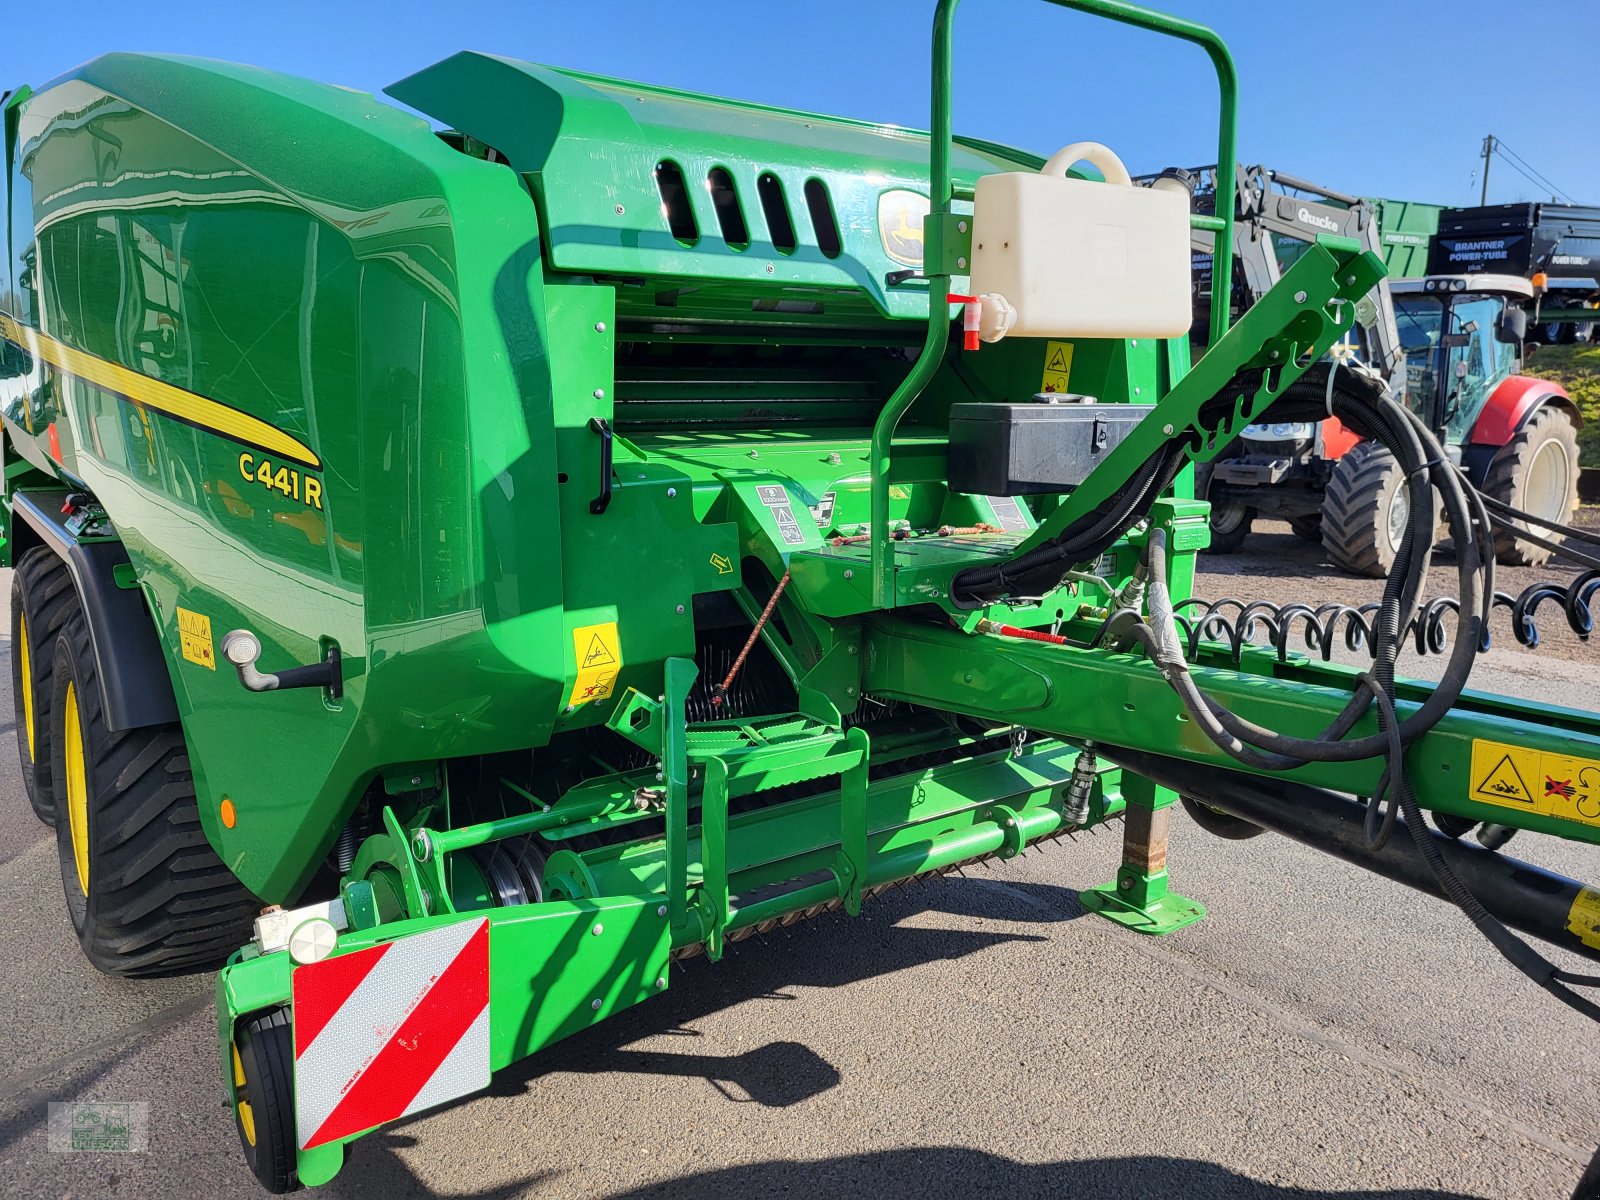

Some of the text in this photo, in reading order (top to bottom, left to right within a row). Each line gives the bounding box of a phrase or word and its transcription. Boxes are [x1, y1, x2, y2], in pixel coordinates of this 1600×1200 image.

[1454, 240, 1505, 251] BRANTNER
[1192, 254, 1213, 262] BRANT
[1449, 250, 1508, 262] POWER-TUBE
